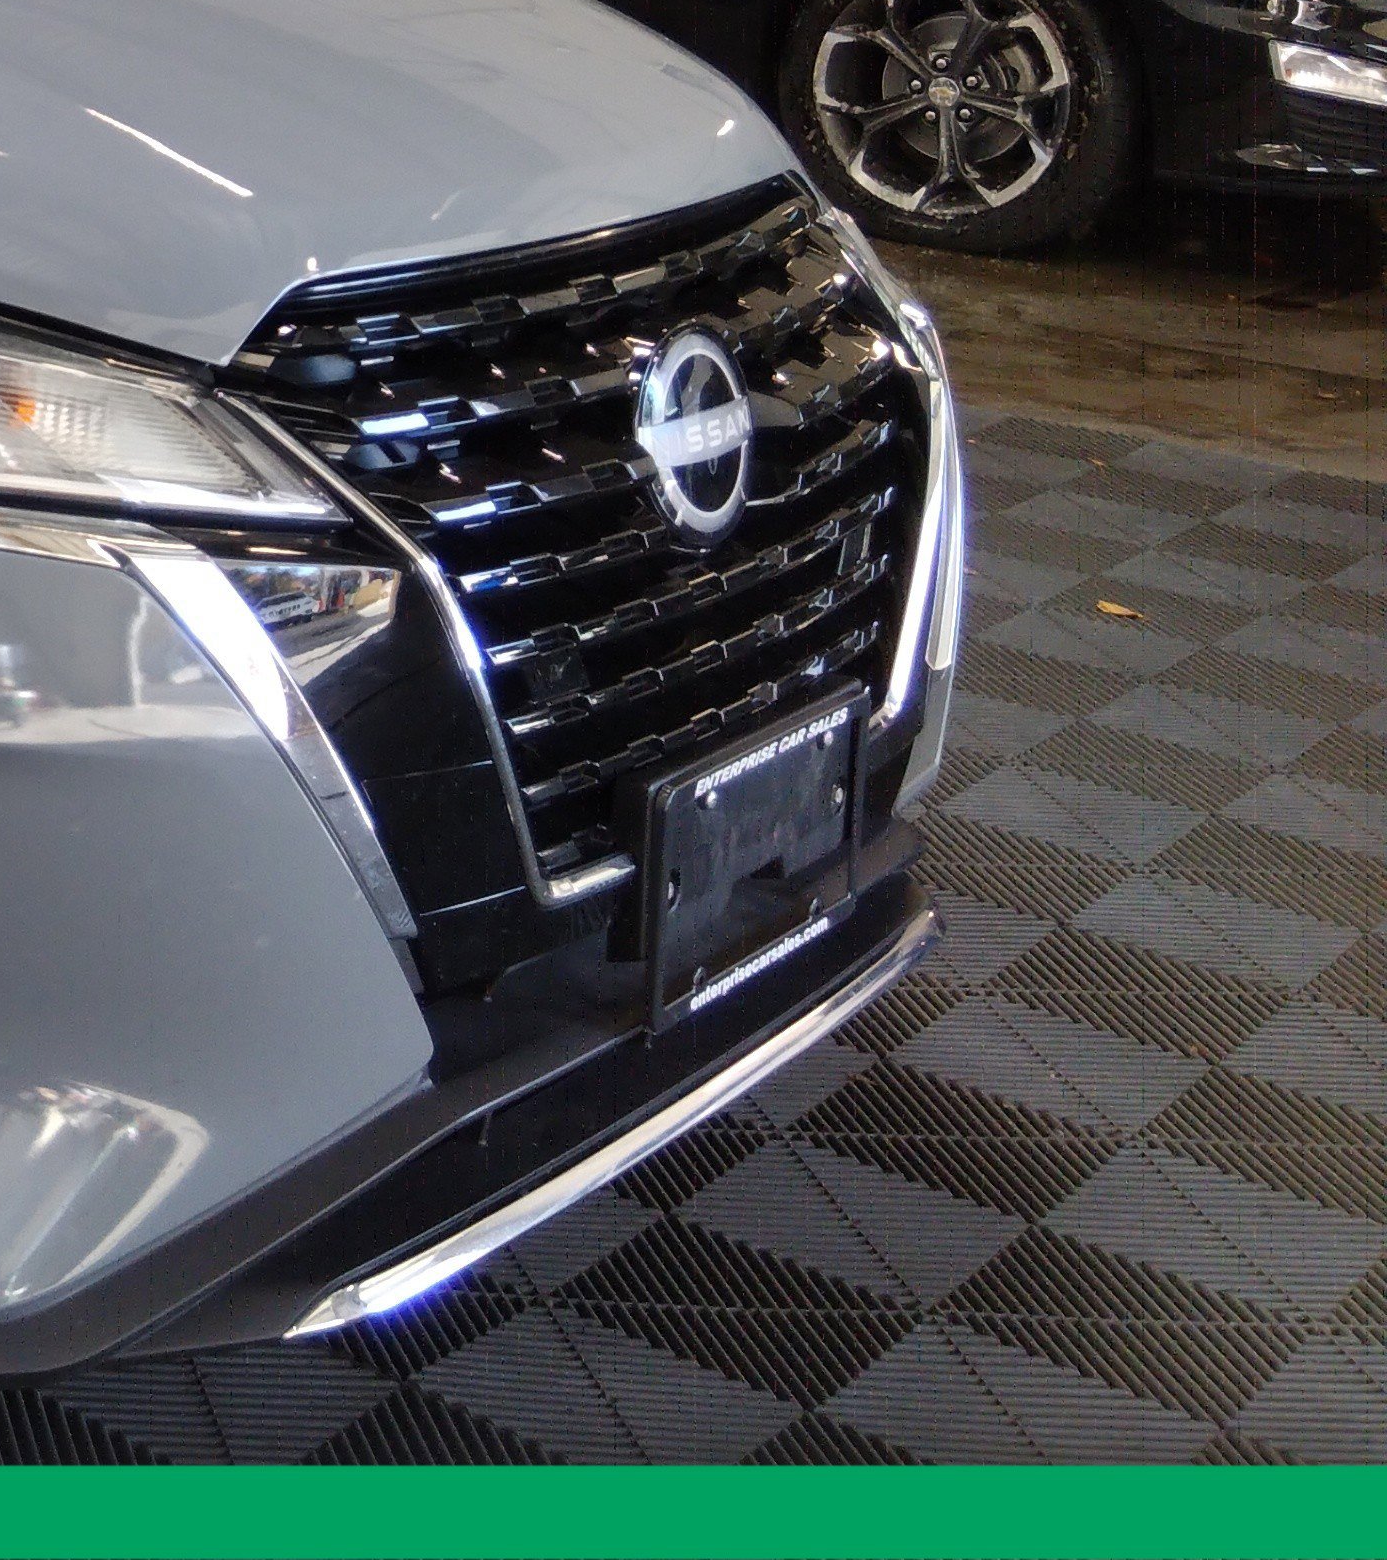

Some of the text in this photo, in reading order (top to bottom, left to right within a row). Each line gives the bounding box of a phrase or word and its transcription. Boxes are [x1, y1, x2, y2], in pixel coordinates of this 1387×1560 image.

[694, 707, 849, 799] ENTERPRISE CAR SALES
[689, 916, 829, 1011] enterprisecarsales.com
